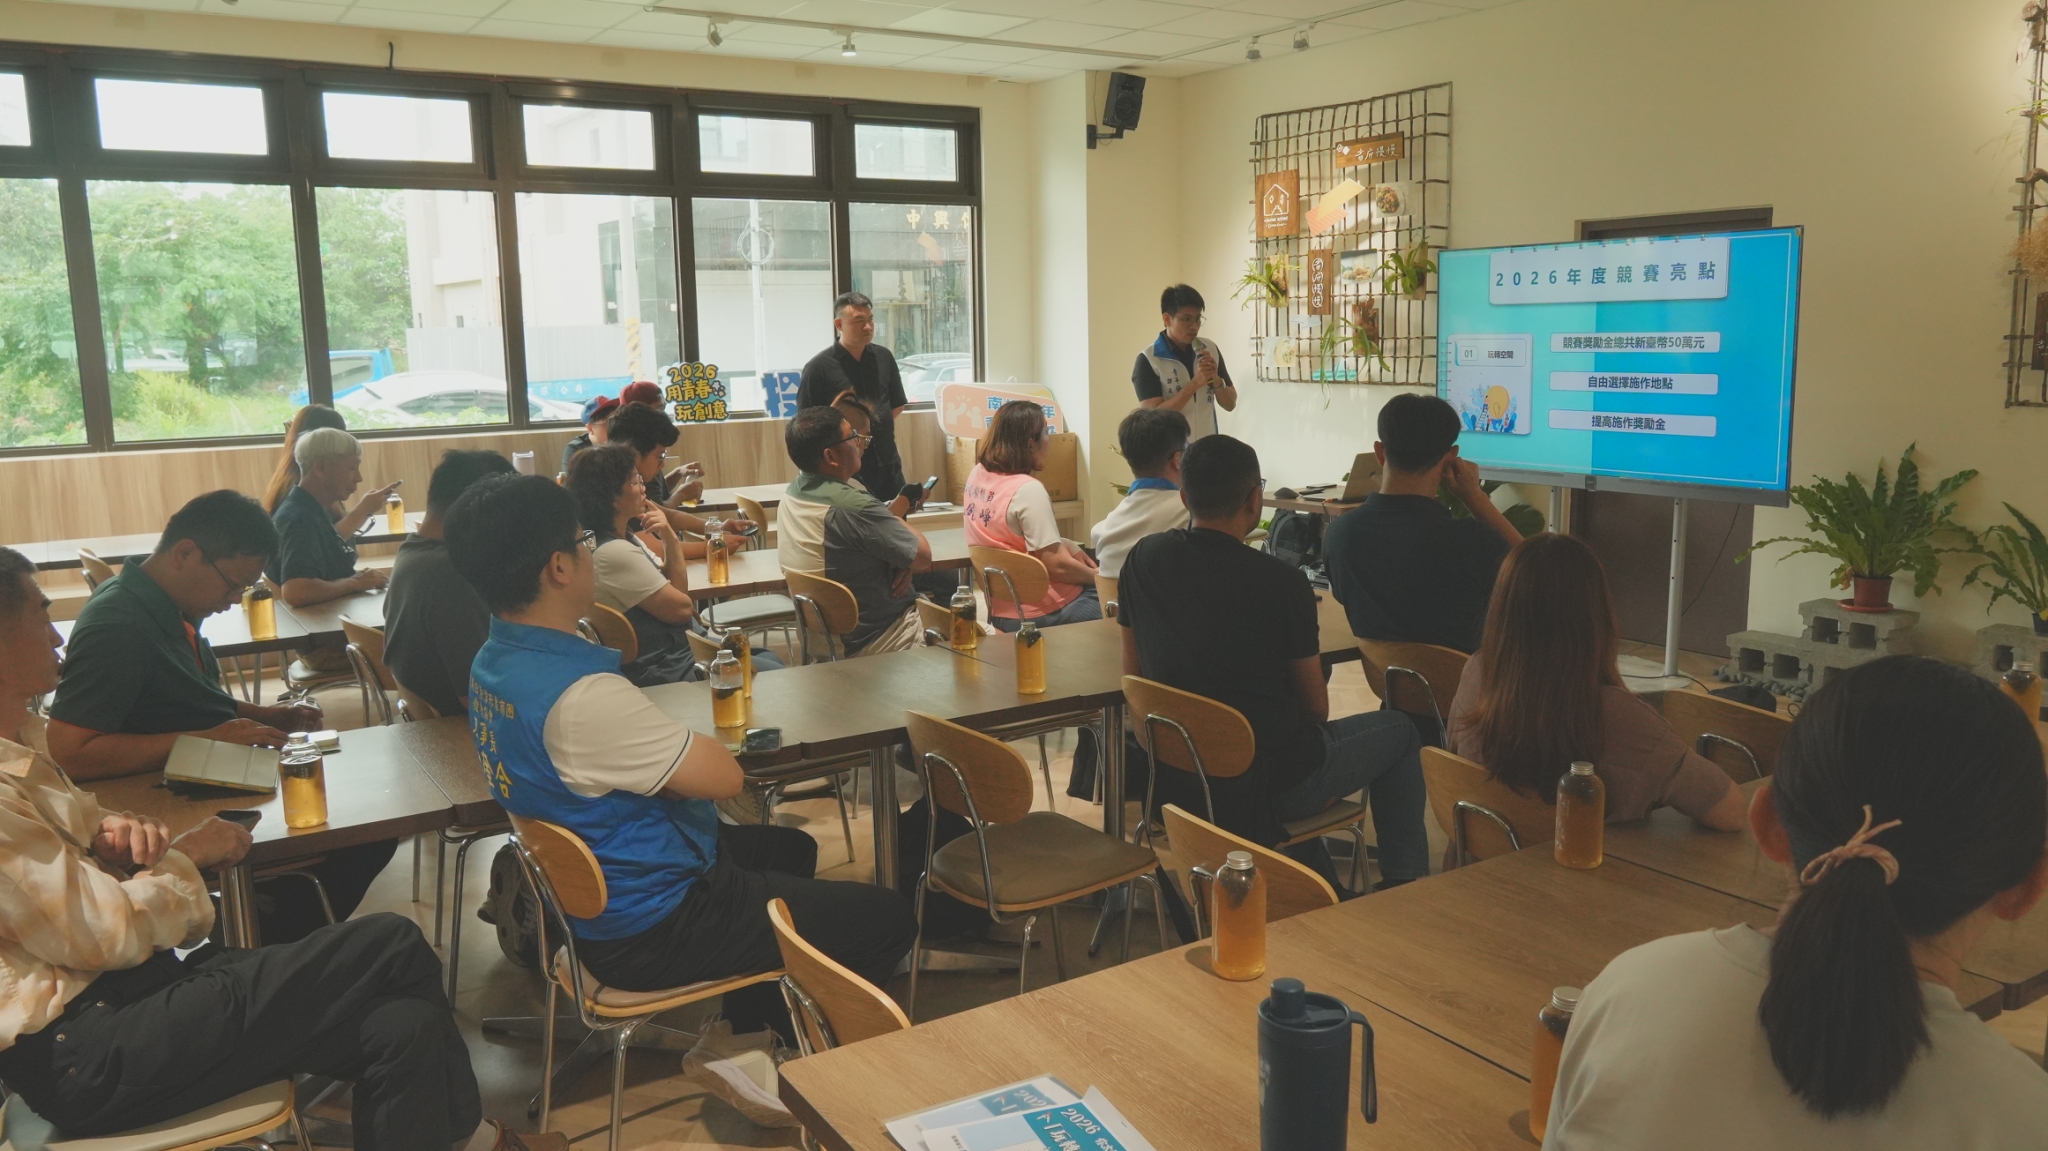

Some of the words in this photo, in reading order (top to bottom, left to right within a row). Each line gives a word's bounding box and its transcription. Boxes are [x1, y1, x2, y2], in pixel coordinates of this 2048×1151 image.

[1496, 261, 1716, 286] 2026年度競賽亮點
[1464, 349, 1473, 358] 01
[1487, 350, 1514, 359] 玩轉空間
[669, 363, 718, 383] 2026
[1587, 376, 1673, 389] 自由選擇施作地點
[666, 379, 712, 402] 用青春
[675, 400, 728, 421] 玩創意
[987, 396, 1055, 418] 南年
[1591, 415, 1666, 430] 提高施作獎勵金
[1060, 1108, 1101, 1135] 2026
